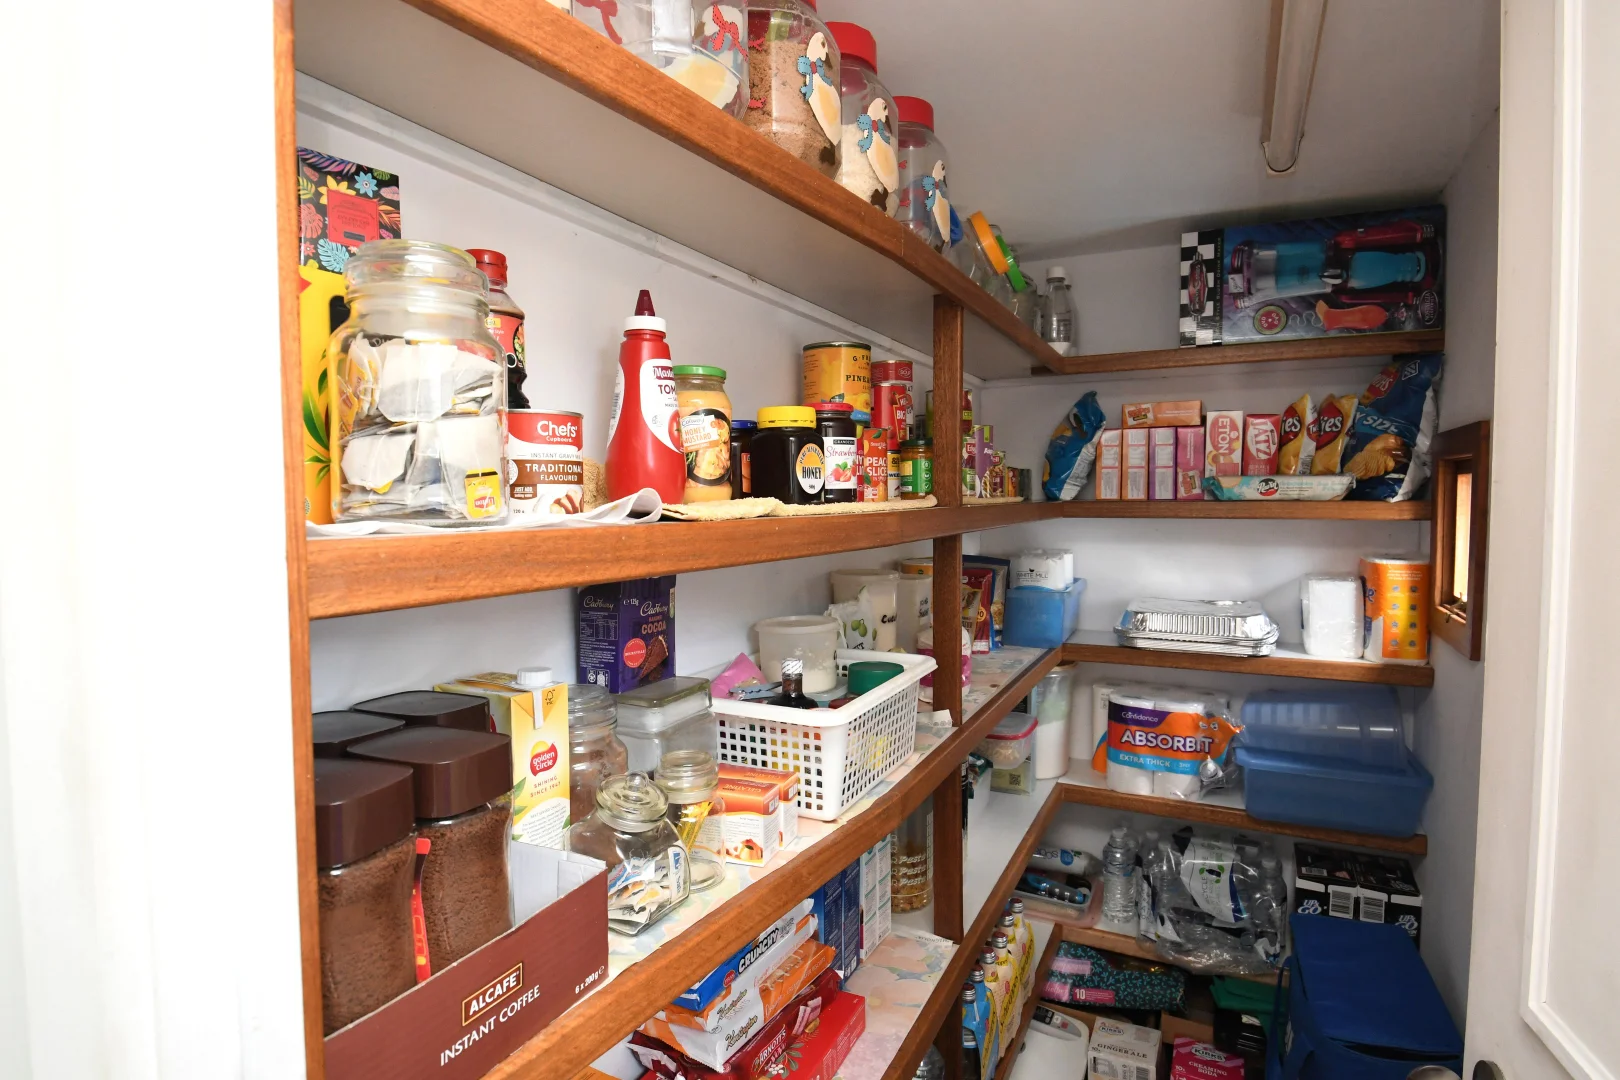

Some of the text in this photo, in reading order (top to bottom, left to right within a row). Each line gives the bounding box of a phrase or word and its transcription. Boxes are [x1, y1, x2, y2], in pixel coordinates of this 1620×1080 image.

[1363, 415, 1398, 434] SIZE
[684, 426, 706, 437] HONEY
[1251, 418, 1273, 458] JATZ
[683, 433, 712, 444] MUSTARD
[525, 463, 583, 474] TRADITIONAL
[802, 466, 822, 480] HONEY
[540, 474, 578, 482] FLAVOURED
[584, 596, 615, 611] Cadbury
[640, 601, 668, 616] Cadbury
[641, 620, 667, 635] COCOA
[1121, 711, 1159, 723] Confidence
[533, 751, 555, 767] golden
[535, 758, 553, 771] circle
[1119, 754, 1171, 768] EXTRA THICK
[533, 775, 558, 788] SHINING
[722, 783, 762, 793] GELATINE
[530, 786, 548, 798] SINCE
[1297, 905, 1322, 915] GO
[738, 928, 780, 975] CRUNCHY
[469, 973, 517, 1016] ALCAFE
[575, 984, 580, 994] 6
[1074, 988, 1086, 1000] 10
[440, 985, 541, 1066] INSTANT COFFEE
[1097, 1043, 1148, 1059] GINGER ALE
[1194, 1048, 1224, 1061] KIRKS
[1188, 1061, 1228, 1076] CREAMING
[1197, 1067, 1218, 1077] SODA
